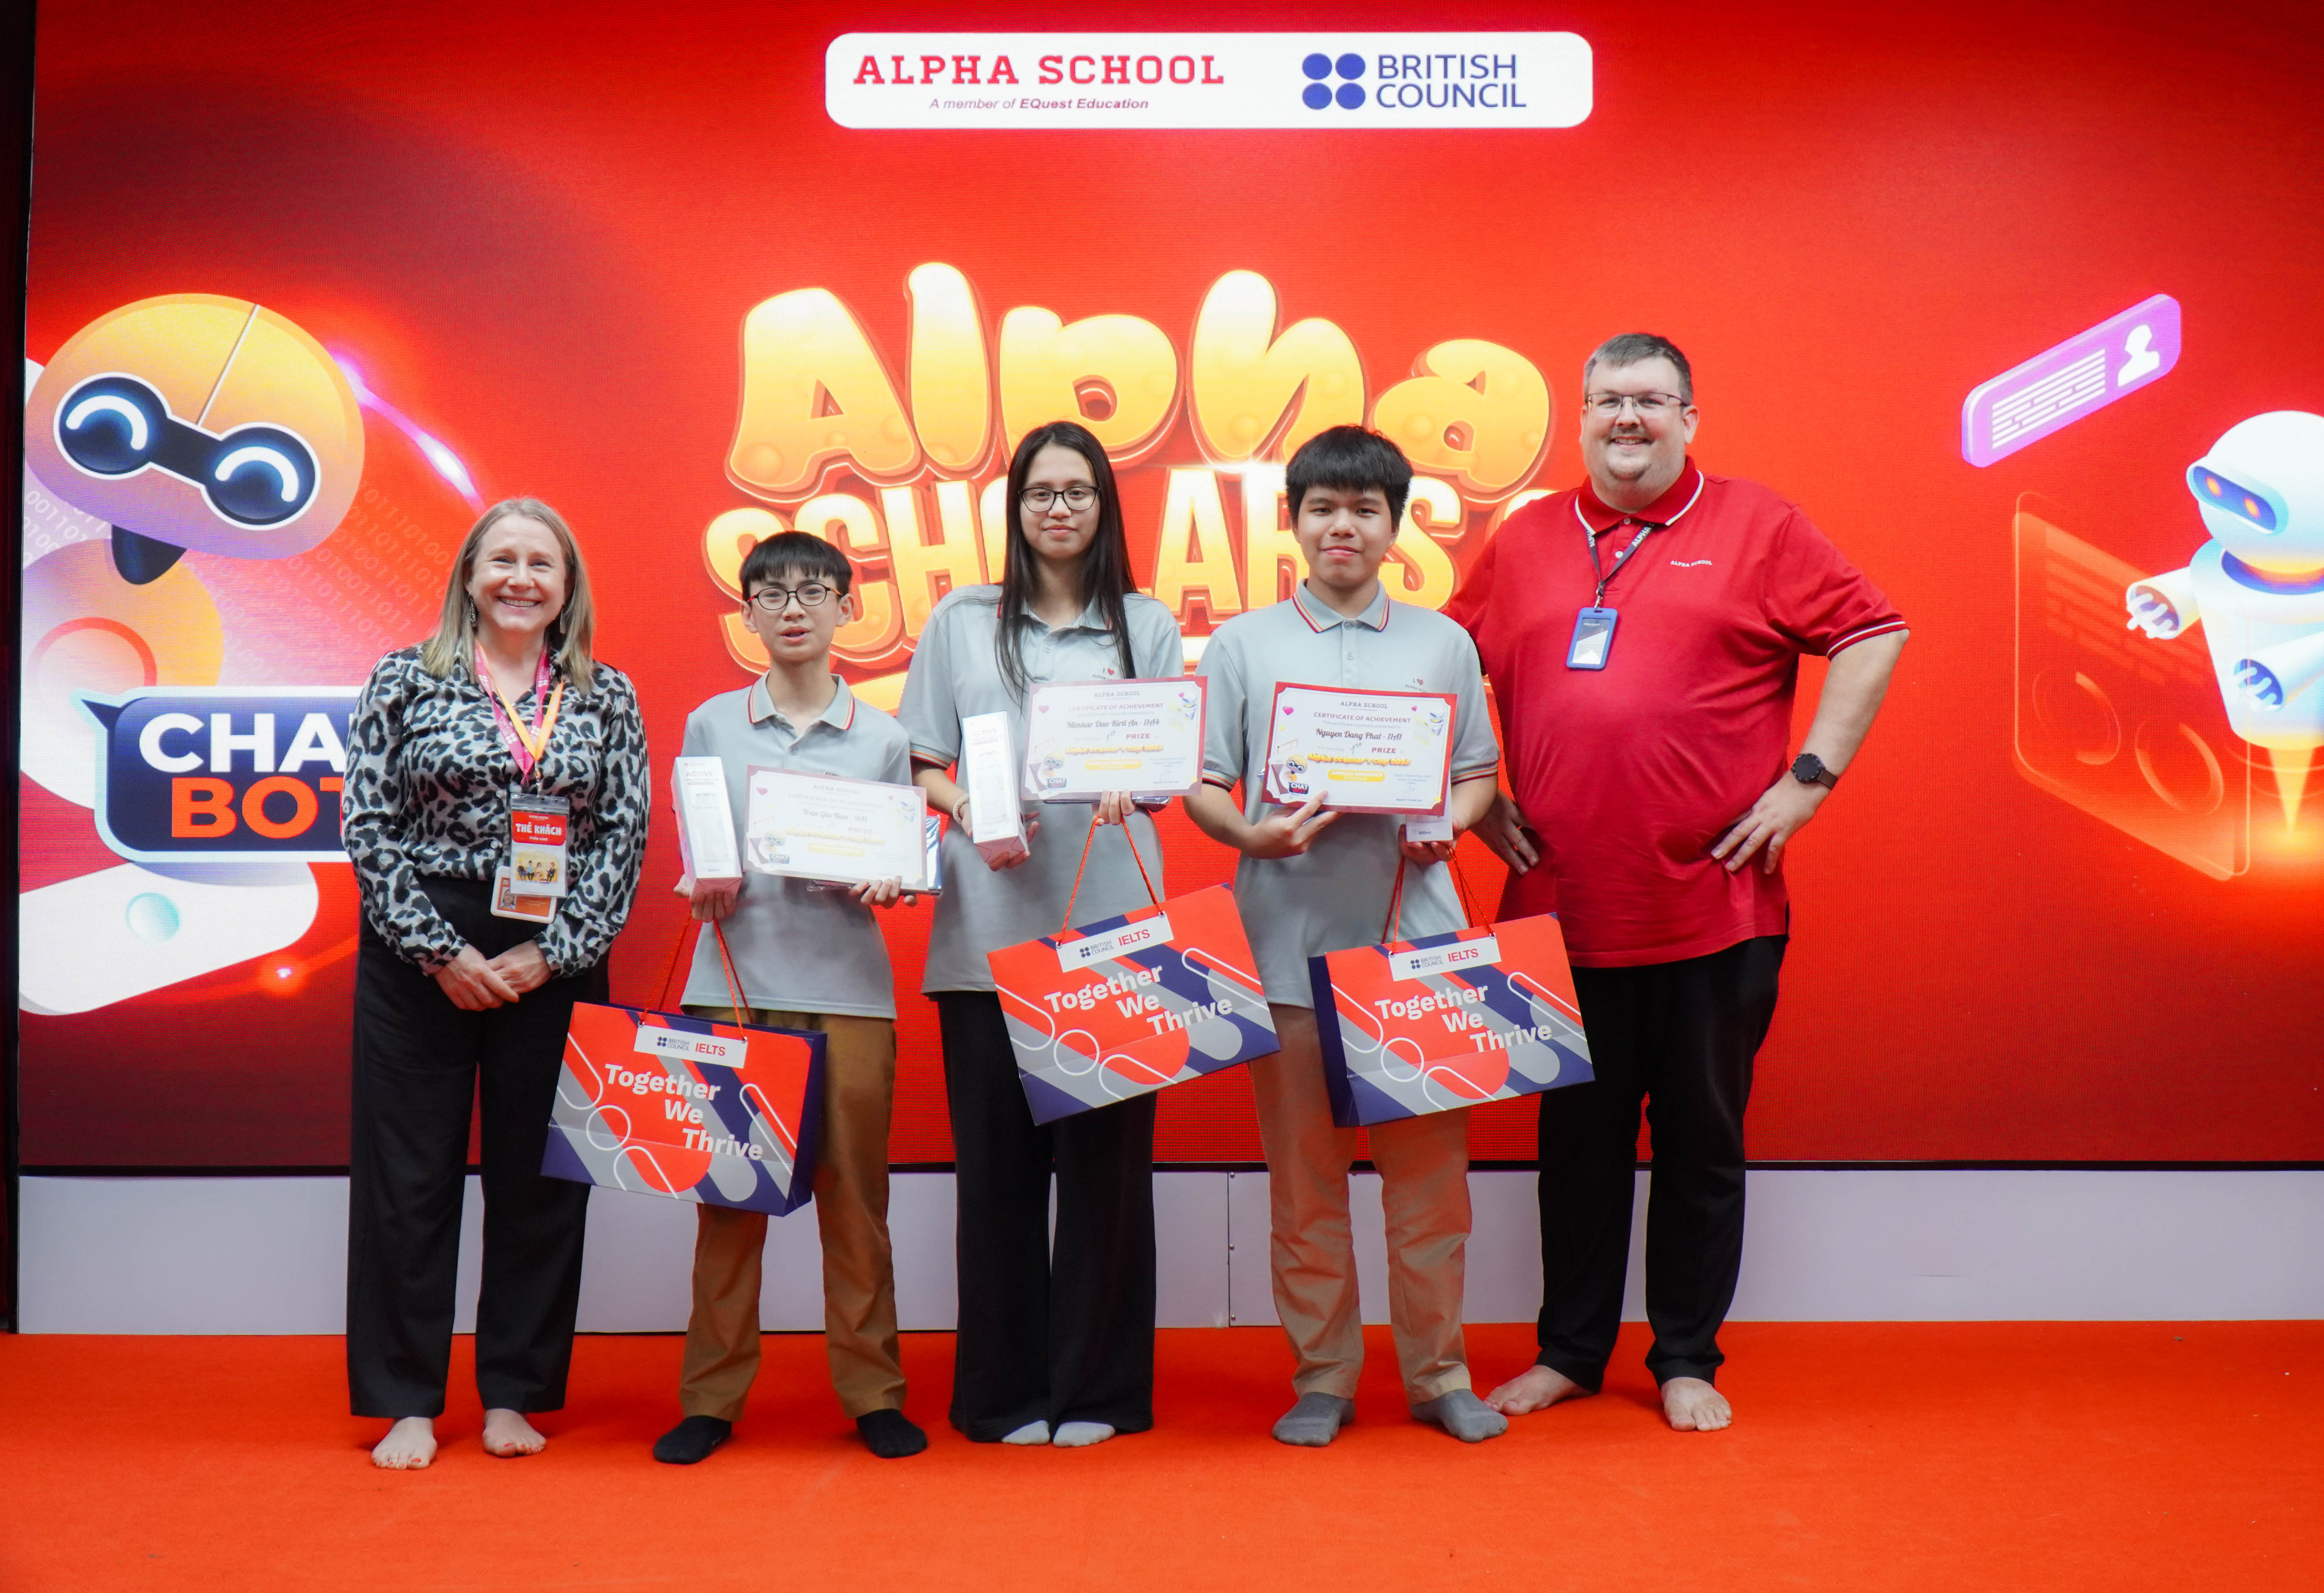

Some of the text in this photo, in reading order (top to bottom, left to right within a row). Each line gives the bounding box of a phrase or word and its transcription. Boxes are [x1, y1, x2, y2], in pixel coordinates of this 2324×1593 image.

[853, 55, 1224, 85] ALPHA SCHOOL
[1378, 54, 1516, 79] BRITISH
[929, 98, 1149, 110] A member of EQuest Education
[1376, 83, 1527, 108] COUNCIL
[729, 261, 1551, 495] Alpha
[1631, 526, 1651, 547] ALPHA
[1314, 712, 1354, 720] CERTIFICATE
[139, 713, 353, 773] CHA
[1315, 728, 1344, 738] Nguyen
[1344, 730, 1363, 740] Dang
[534, 824, 561, 836] KHÁCH
[1090, 940, 1112, 950] BRITISH
[1118, 929, 1150, 947] IELTS
[1091, 944, 1115, 955] COUNCIL
[1420, 955, 1442, 964] BRITISH
[1448, 949, 1479, 962] IELTS
[1421, 959, 1443, 968] COUNCIL
[1044, 965, 1163, 1013] Together
[1116, 994, 1160, 1018] We
[1374, 985, 1489, 1020] Together
[1146, 998, 1233, 1035] Thrive
[1441, 1011, 1484, 1033] We
[667, 1043, 690, 1051] COUNCIL
[668, 1038, 690, 1046] BRITISH
[695, 1042, 726, 1056] IELTS
[1469, 1024, 1552, 1053] Thrive
[605, 1063, 722, 1101] Together
[664, 1099, 704, 1124] We
[682, 1127, 764, 1161] Thrive
